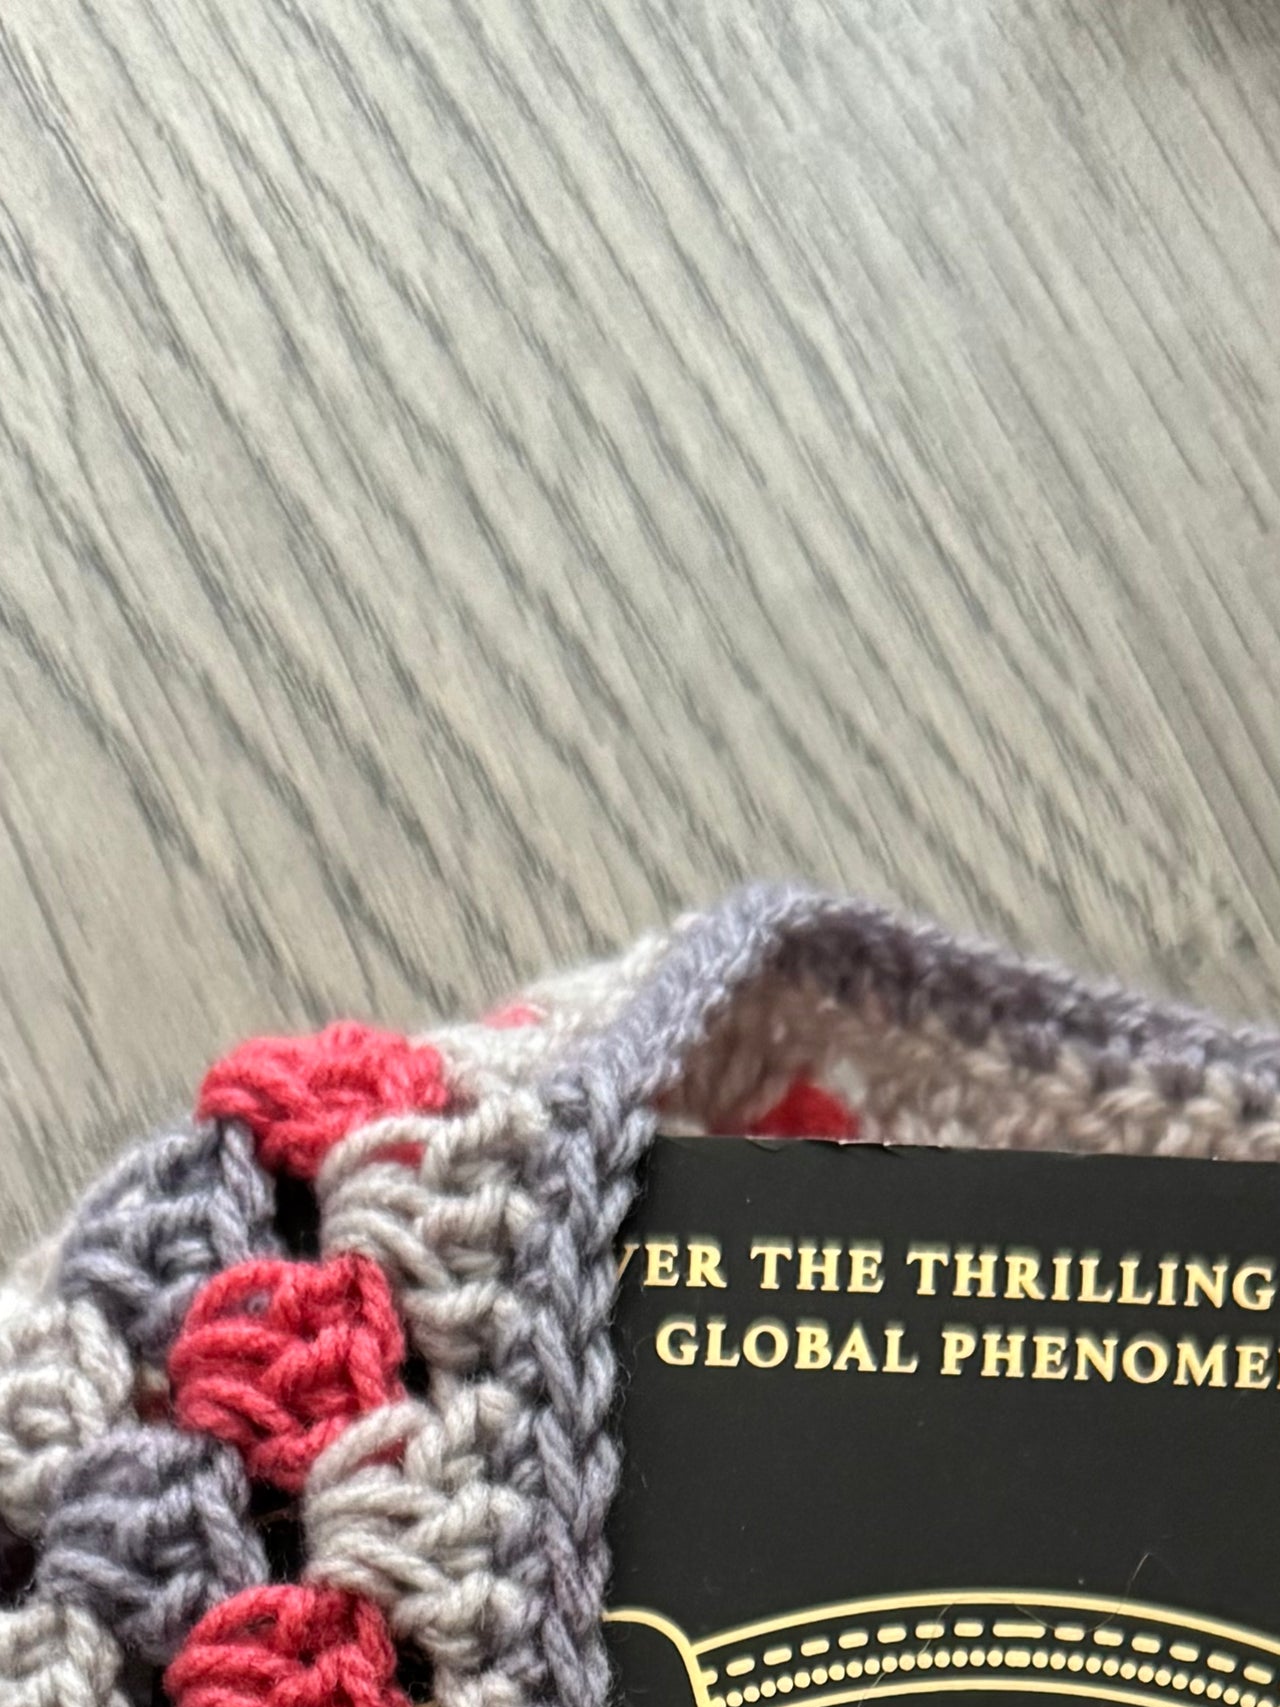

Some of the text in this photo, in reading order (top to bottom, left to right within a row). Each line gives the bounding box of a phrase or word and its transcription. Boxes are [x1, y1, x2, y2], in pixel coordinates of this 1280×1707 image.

[749, 1243, 885, 1294] THE
[905, 1248, 1277, 1312] THRILLING
[654, 1319, 920, 1375] GLOBAL
